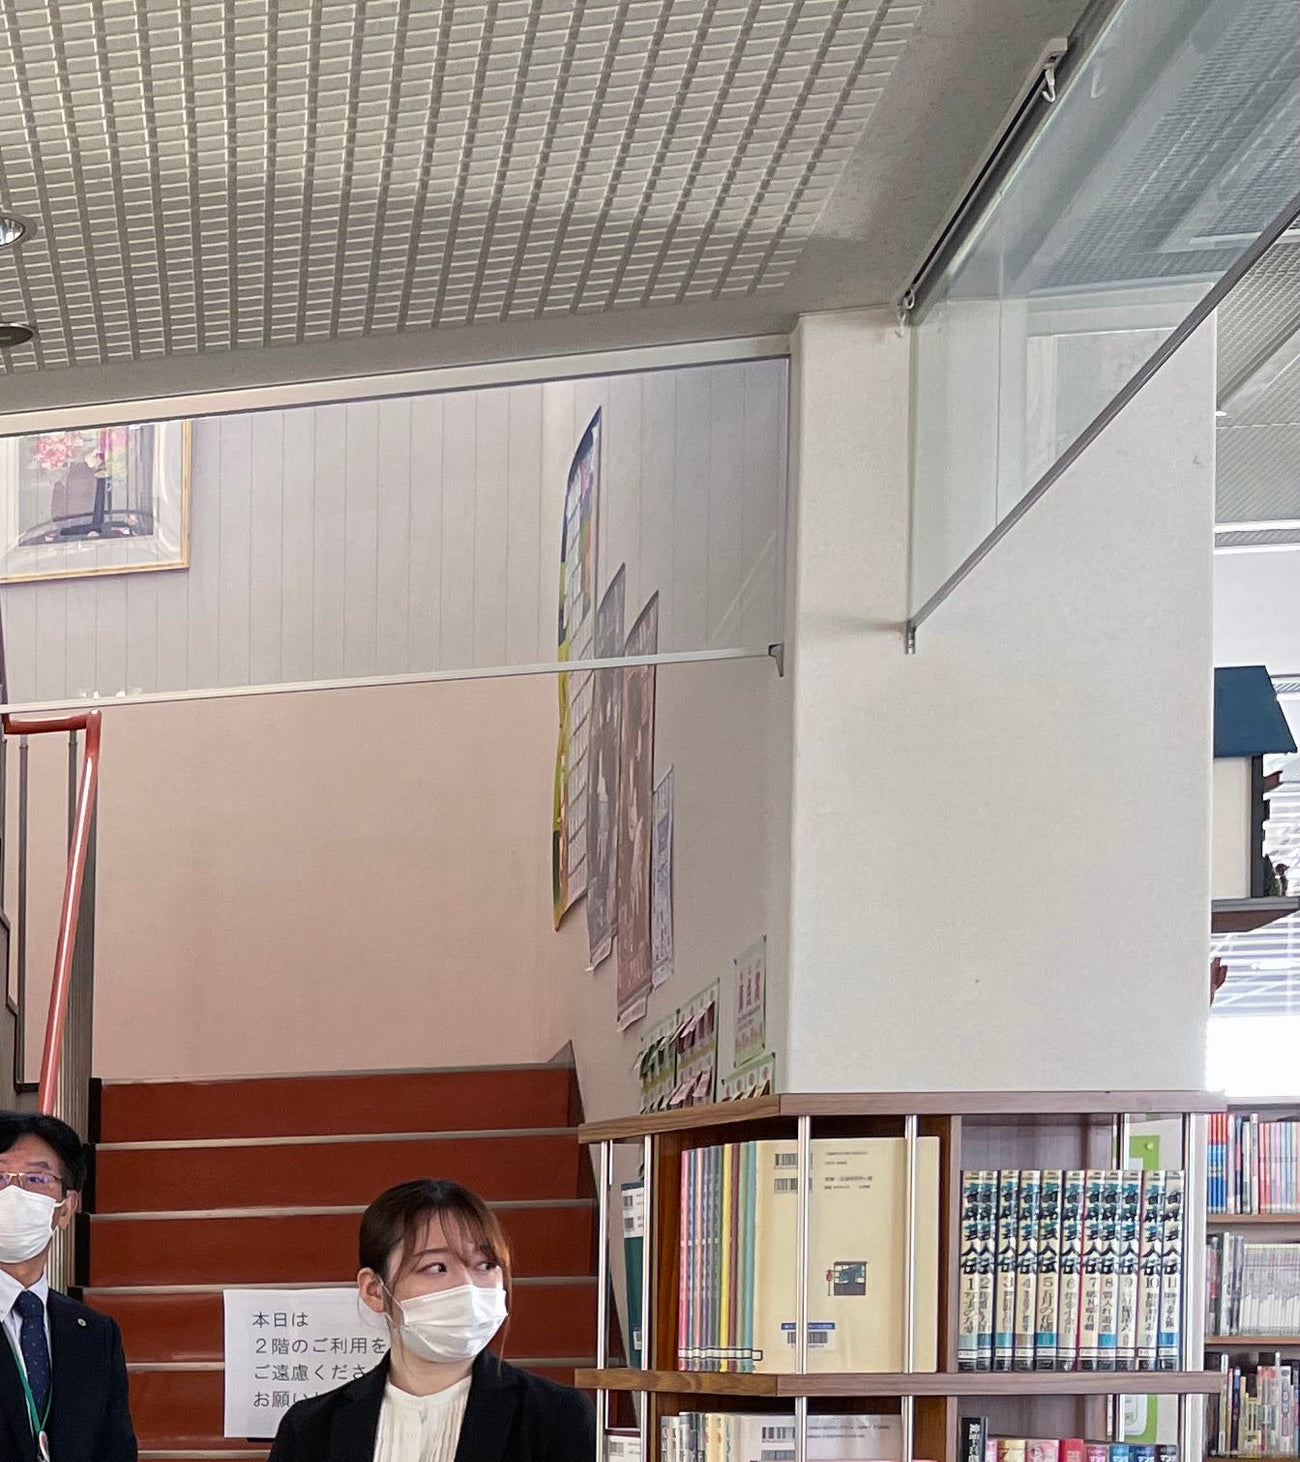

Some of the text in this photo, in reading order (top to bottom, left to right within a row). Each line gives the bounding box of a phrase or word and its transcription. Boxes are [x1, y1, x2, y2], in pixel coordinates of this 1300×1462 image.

[252, 1312, 308, 1328] 本日は
[255, 1337, 386, 1355] 2階のご利用を
